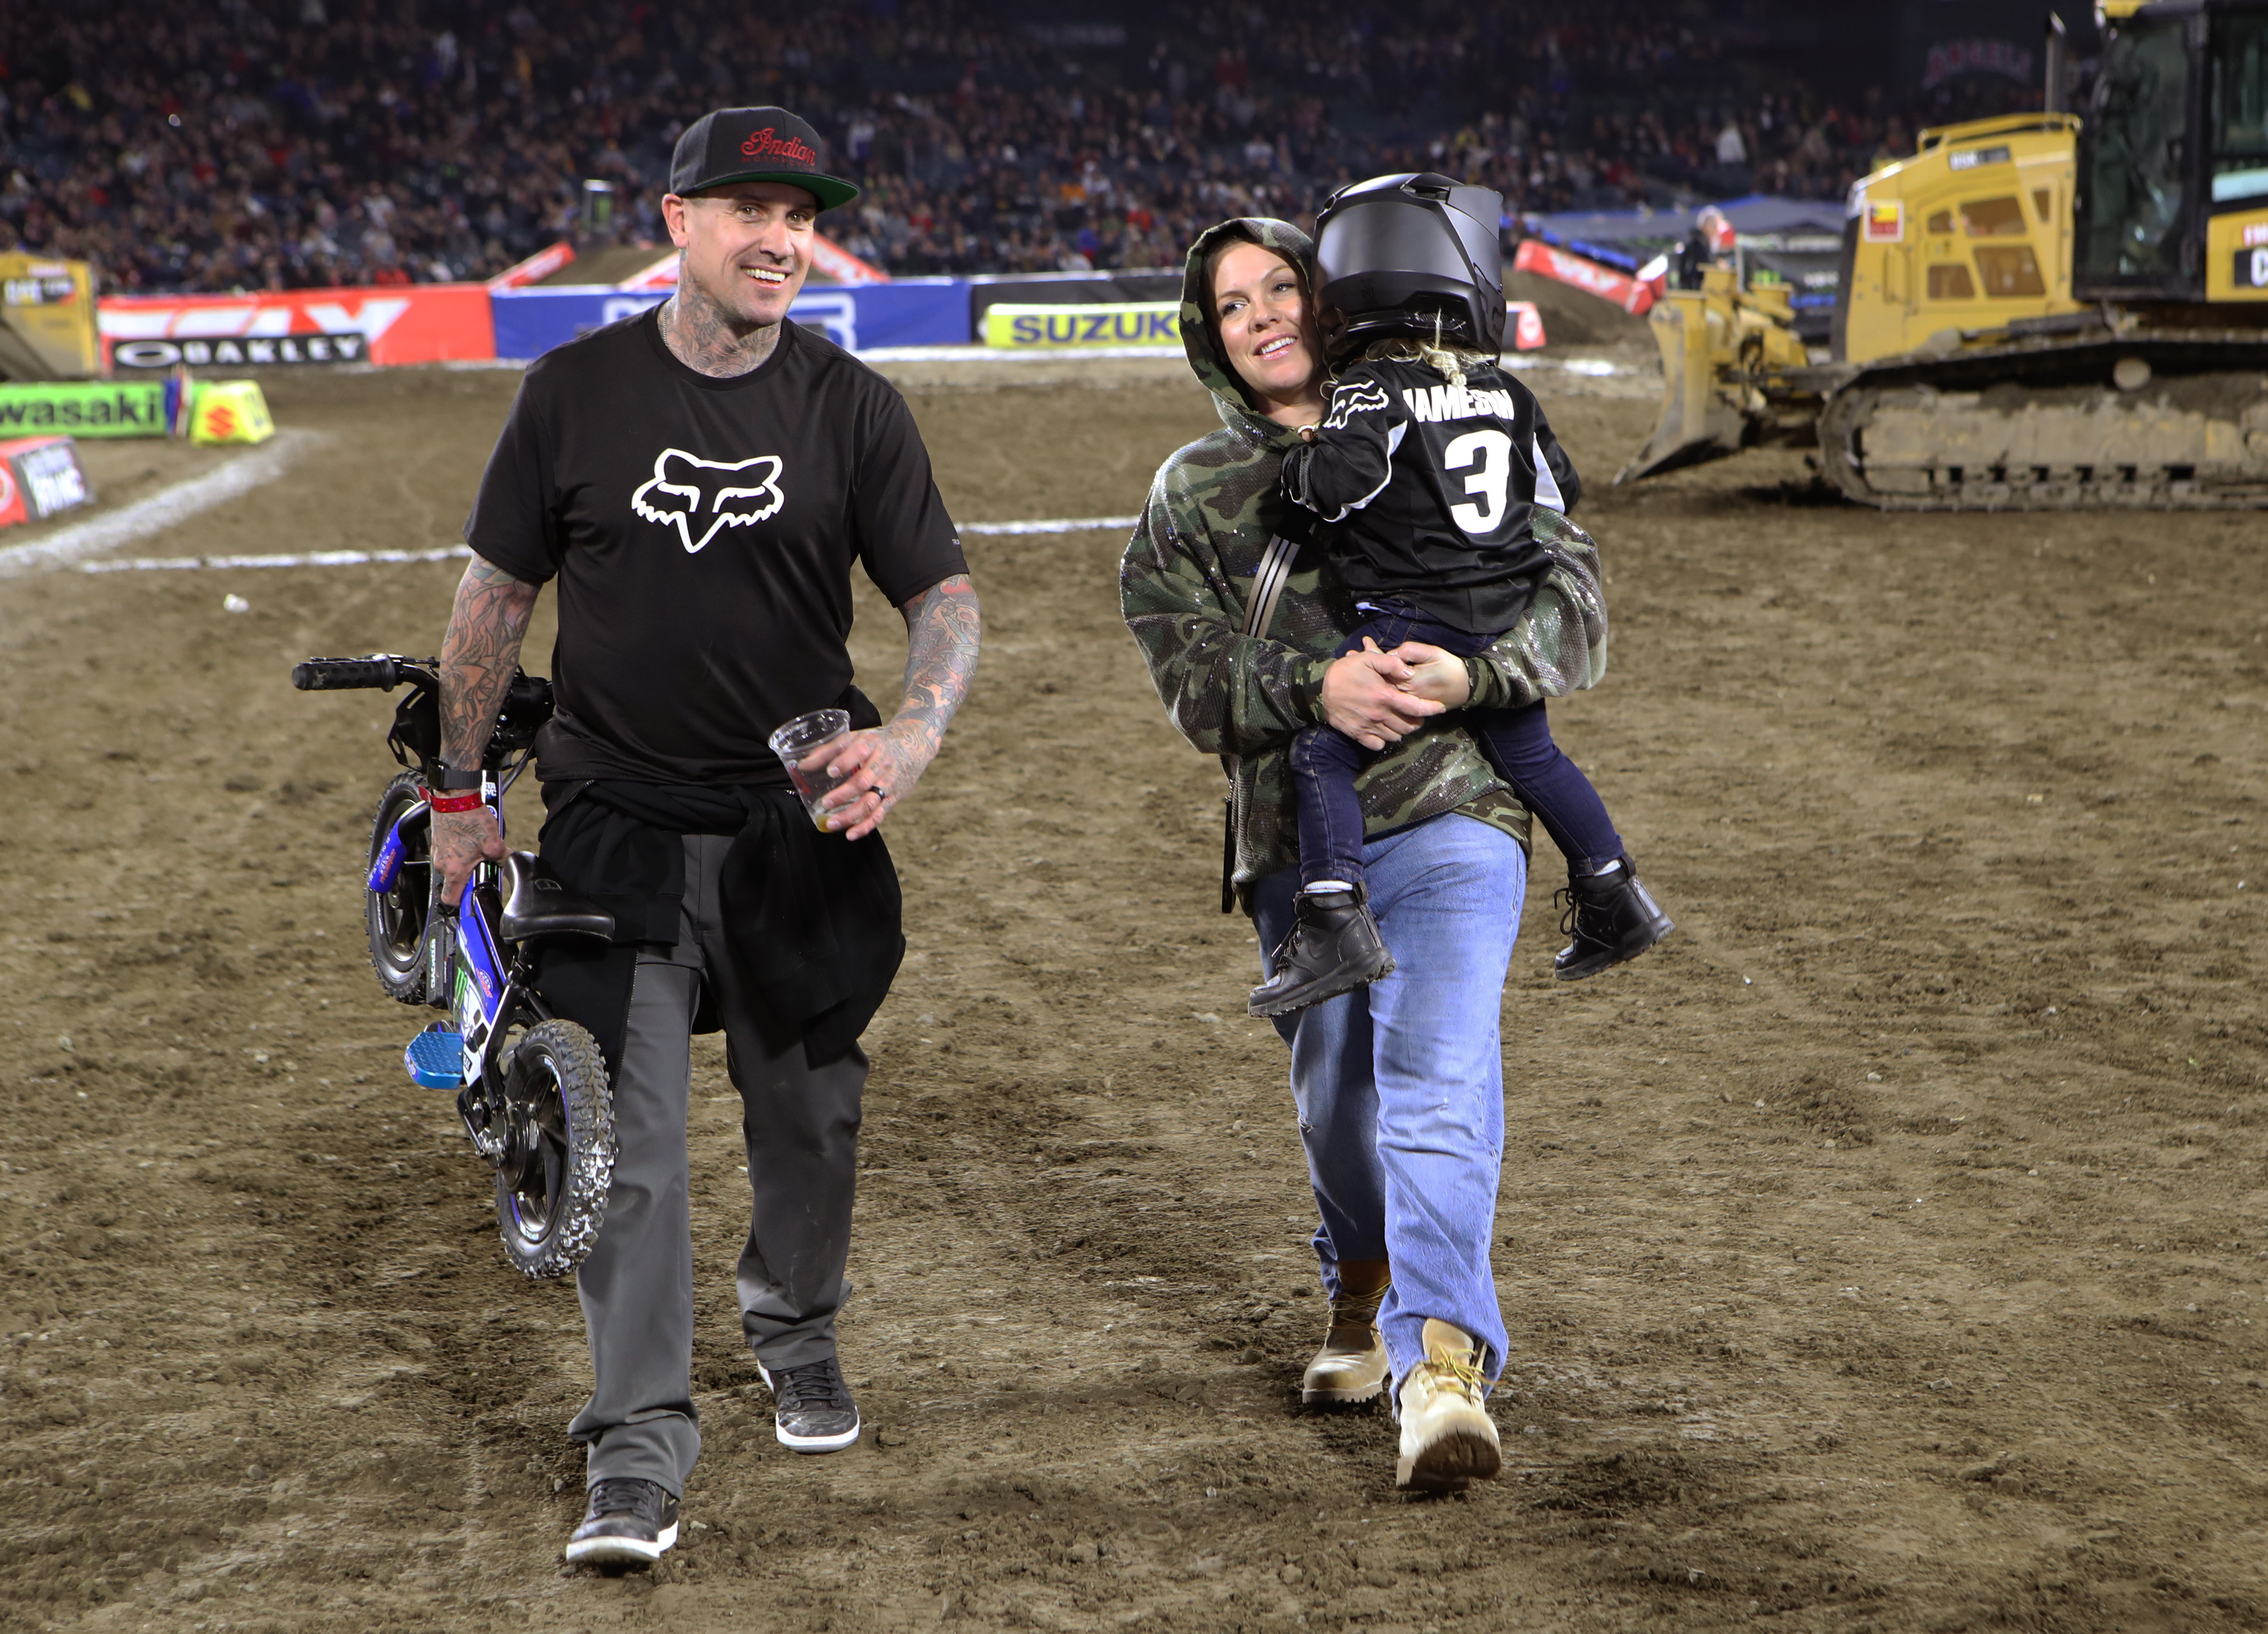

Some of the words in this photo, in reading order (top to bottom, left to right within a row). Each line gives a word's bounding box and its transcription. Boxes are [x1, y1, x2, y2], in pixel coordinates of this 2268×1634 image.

[740, 127, 816, 166] Indian
[182, 337, 361, 365] OAKLEY
[1445, 430, 1512, 534] 3
